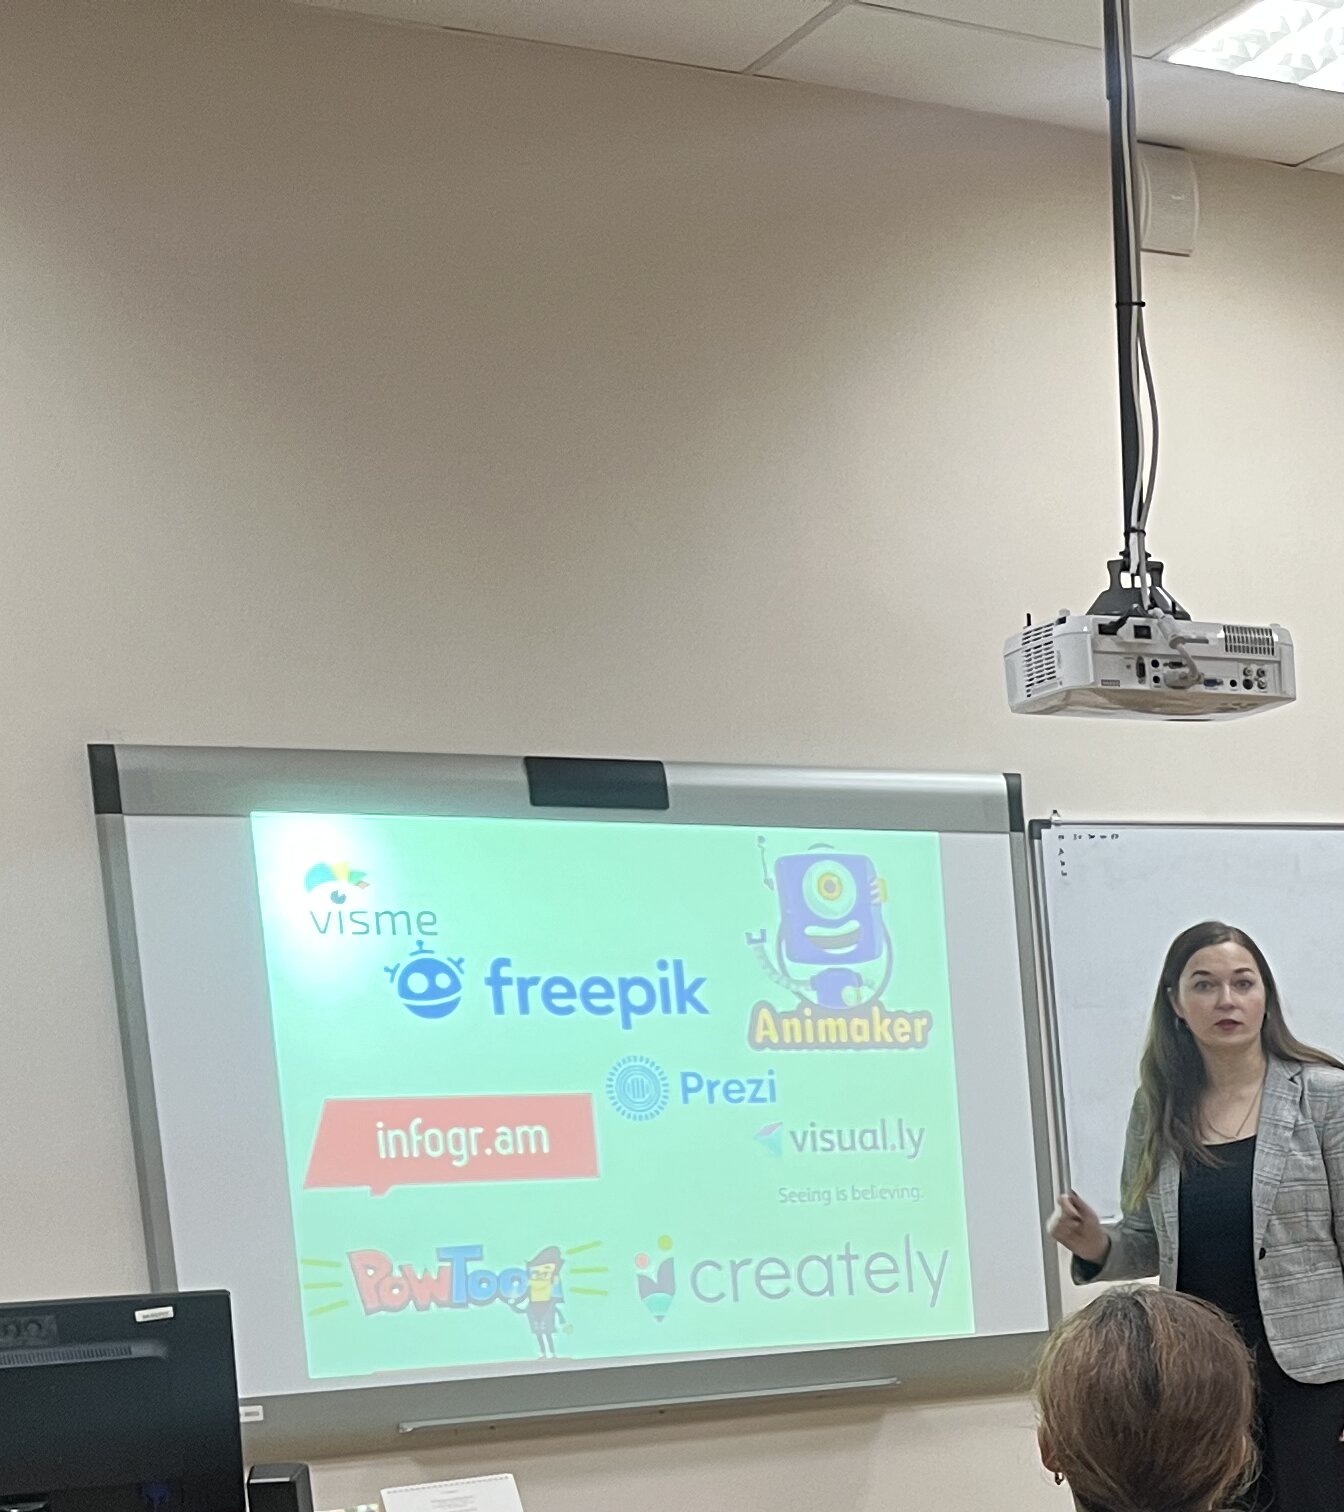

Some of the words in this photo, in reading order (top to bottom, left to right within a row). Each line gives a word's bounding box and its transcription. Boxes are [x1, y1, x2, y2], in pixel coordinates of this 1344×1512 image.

[309, 909, 439, 936] visme
[484, 957, 710, 1029] freepik
[754, 1007, 930, 1046] Animaker
[681, 1069, 777, 1104] Prezi
[377, 1118, 551, 1167] infogr.am
[789, 1118, 925, 1160] visual.ly
[778, 1187, 831, 1205] Seeing
[836, 1187, 848, 1201] is
[690, 1235, 949, 1307] creately
